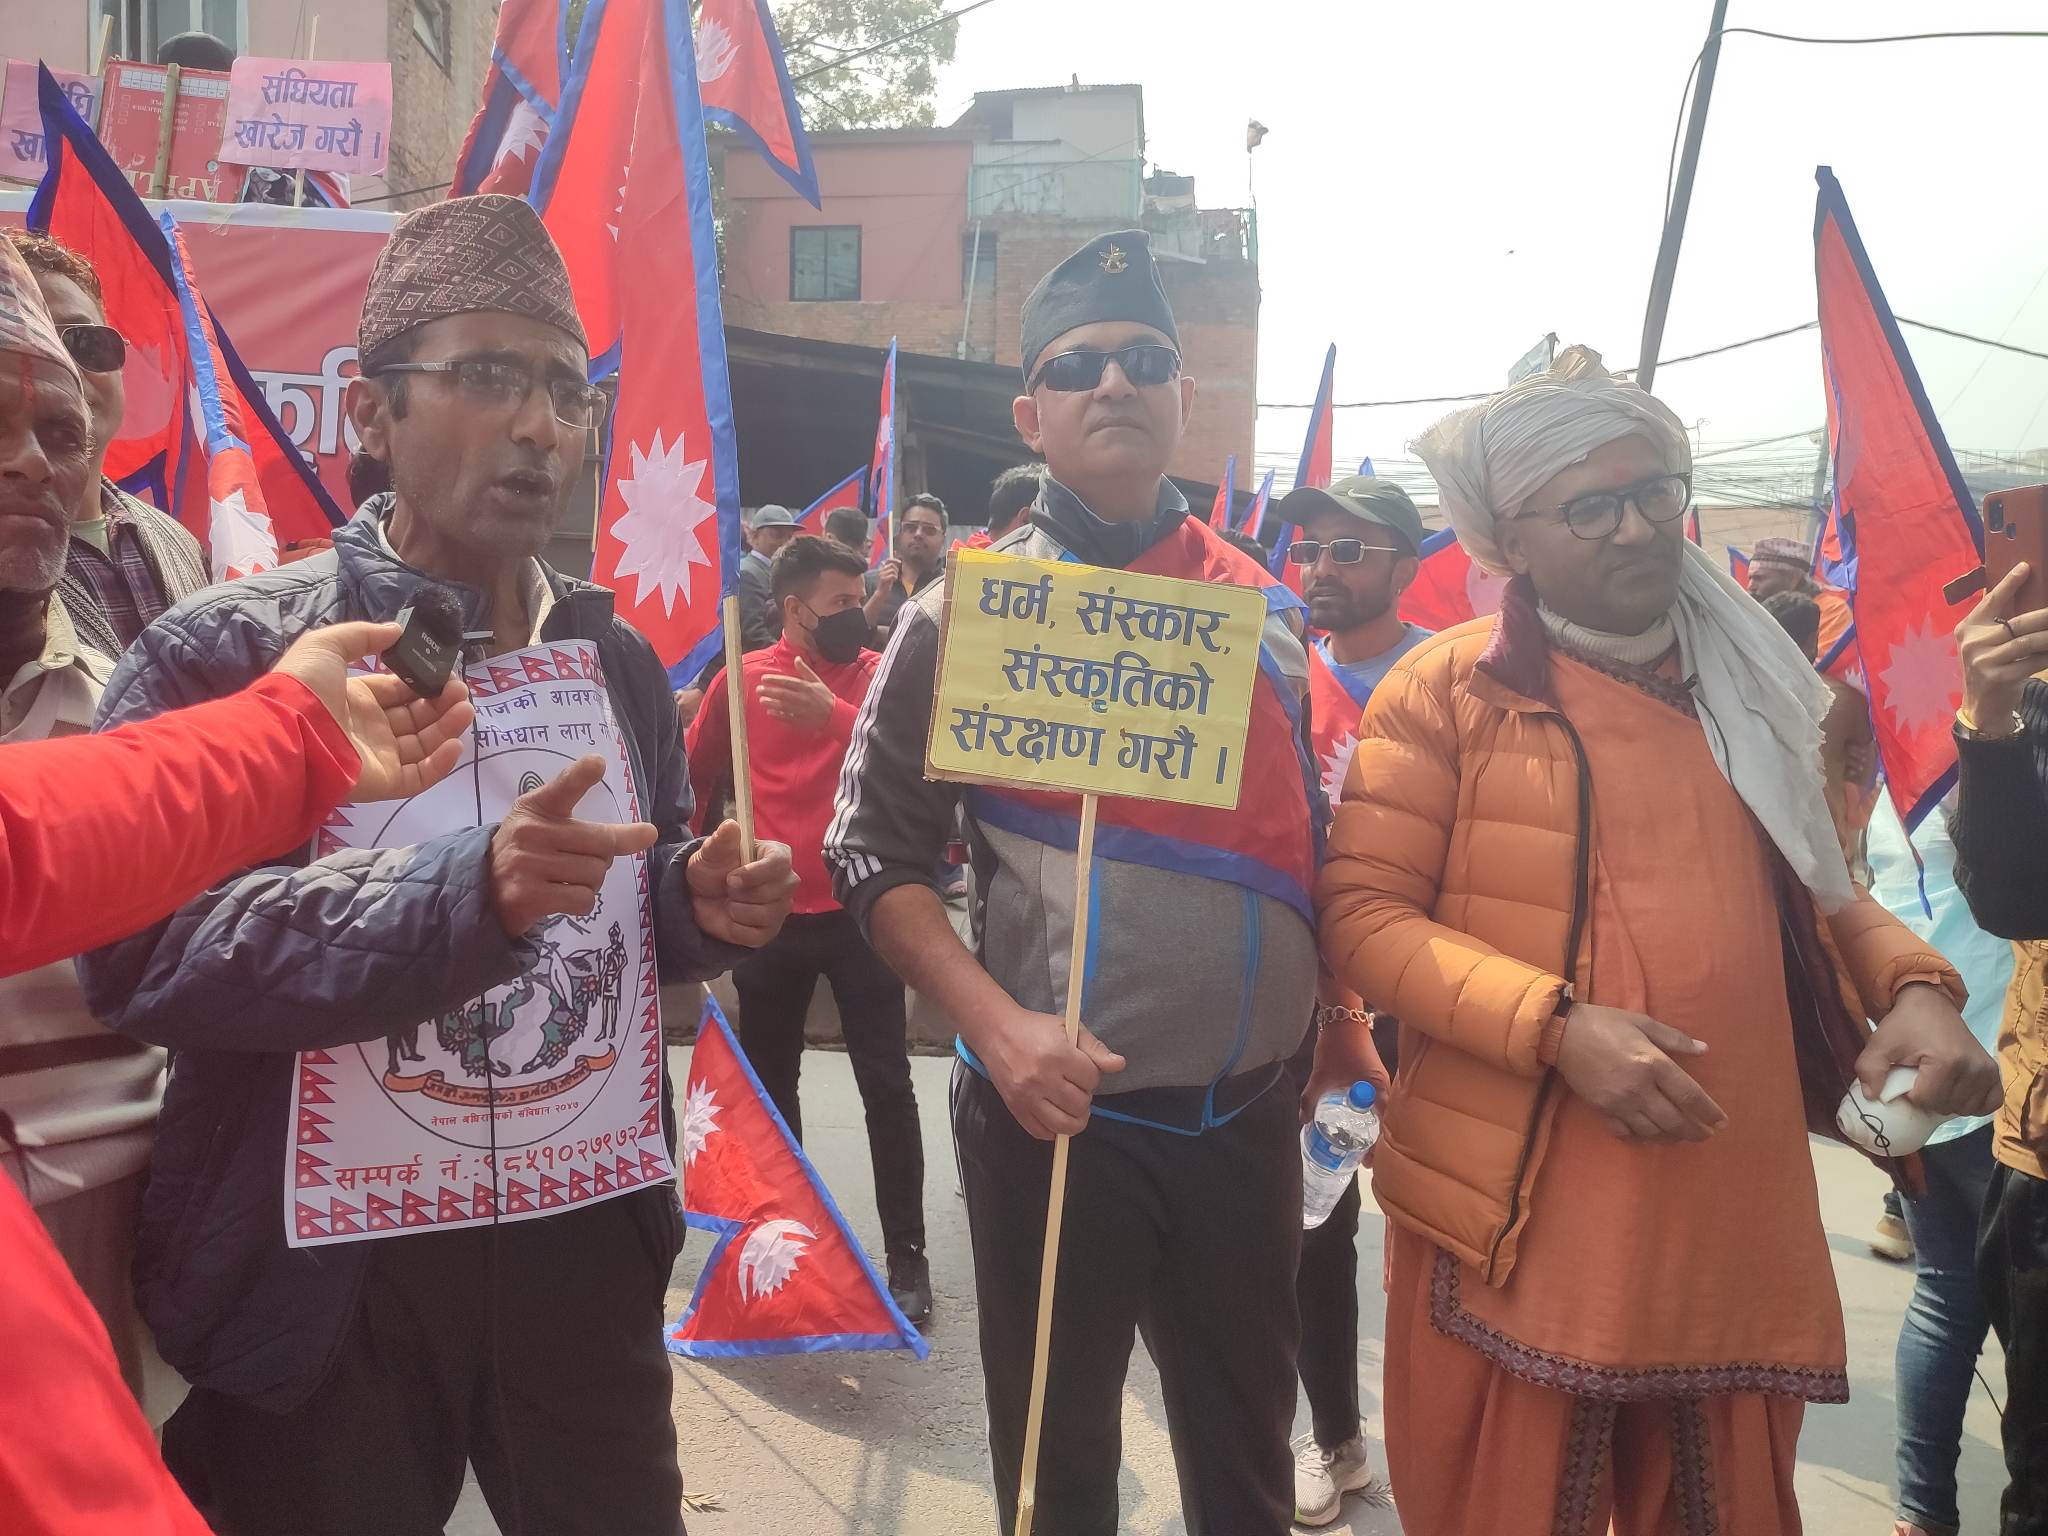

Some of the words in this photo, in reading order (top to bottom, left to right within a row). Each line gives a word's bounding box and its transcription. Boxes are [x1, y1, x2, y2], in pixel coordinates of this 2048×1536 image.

[261, 67, 358, 109] संघियता
[234, 113, 307, 152] खारेज
[979, 575, 1056, 630] धर्म,
[1076, 586, 1231, 655] संस्कार,
[1001, 643, 1214, 715] संस्कृतिको
[558, 723, 595, 746] लागु
[950, 703, 1106, 766] संरक्षण
[1117, 725, 1198, 780] गरौ
[431, 1115, 457, 1127] नेपाल
[517, 1106, 550, 1118] संविधान
[333, 1153, 423, 1191] सम्पर्क
